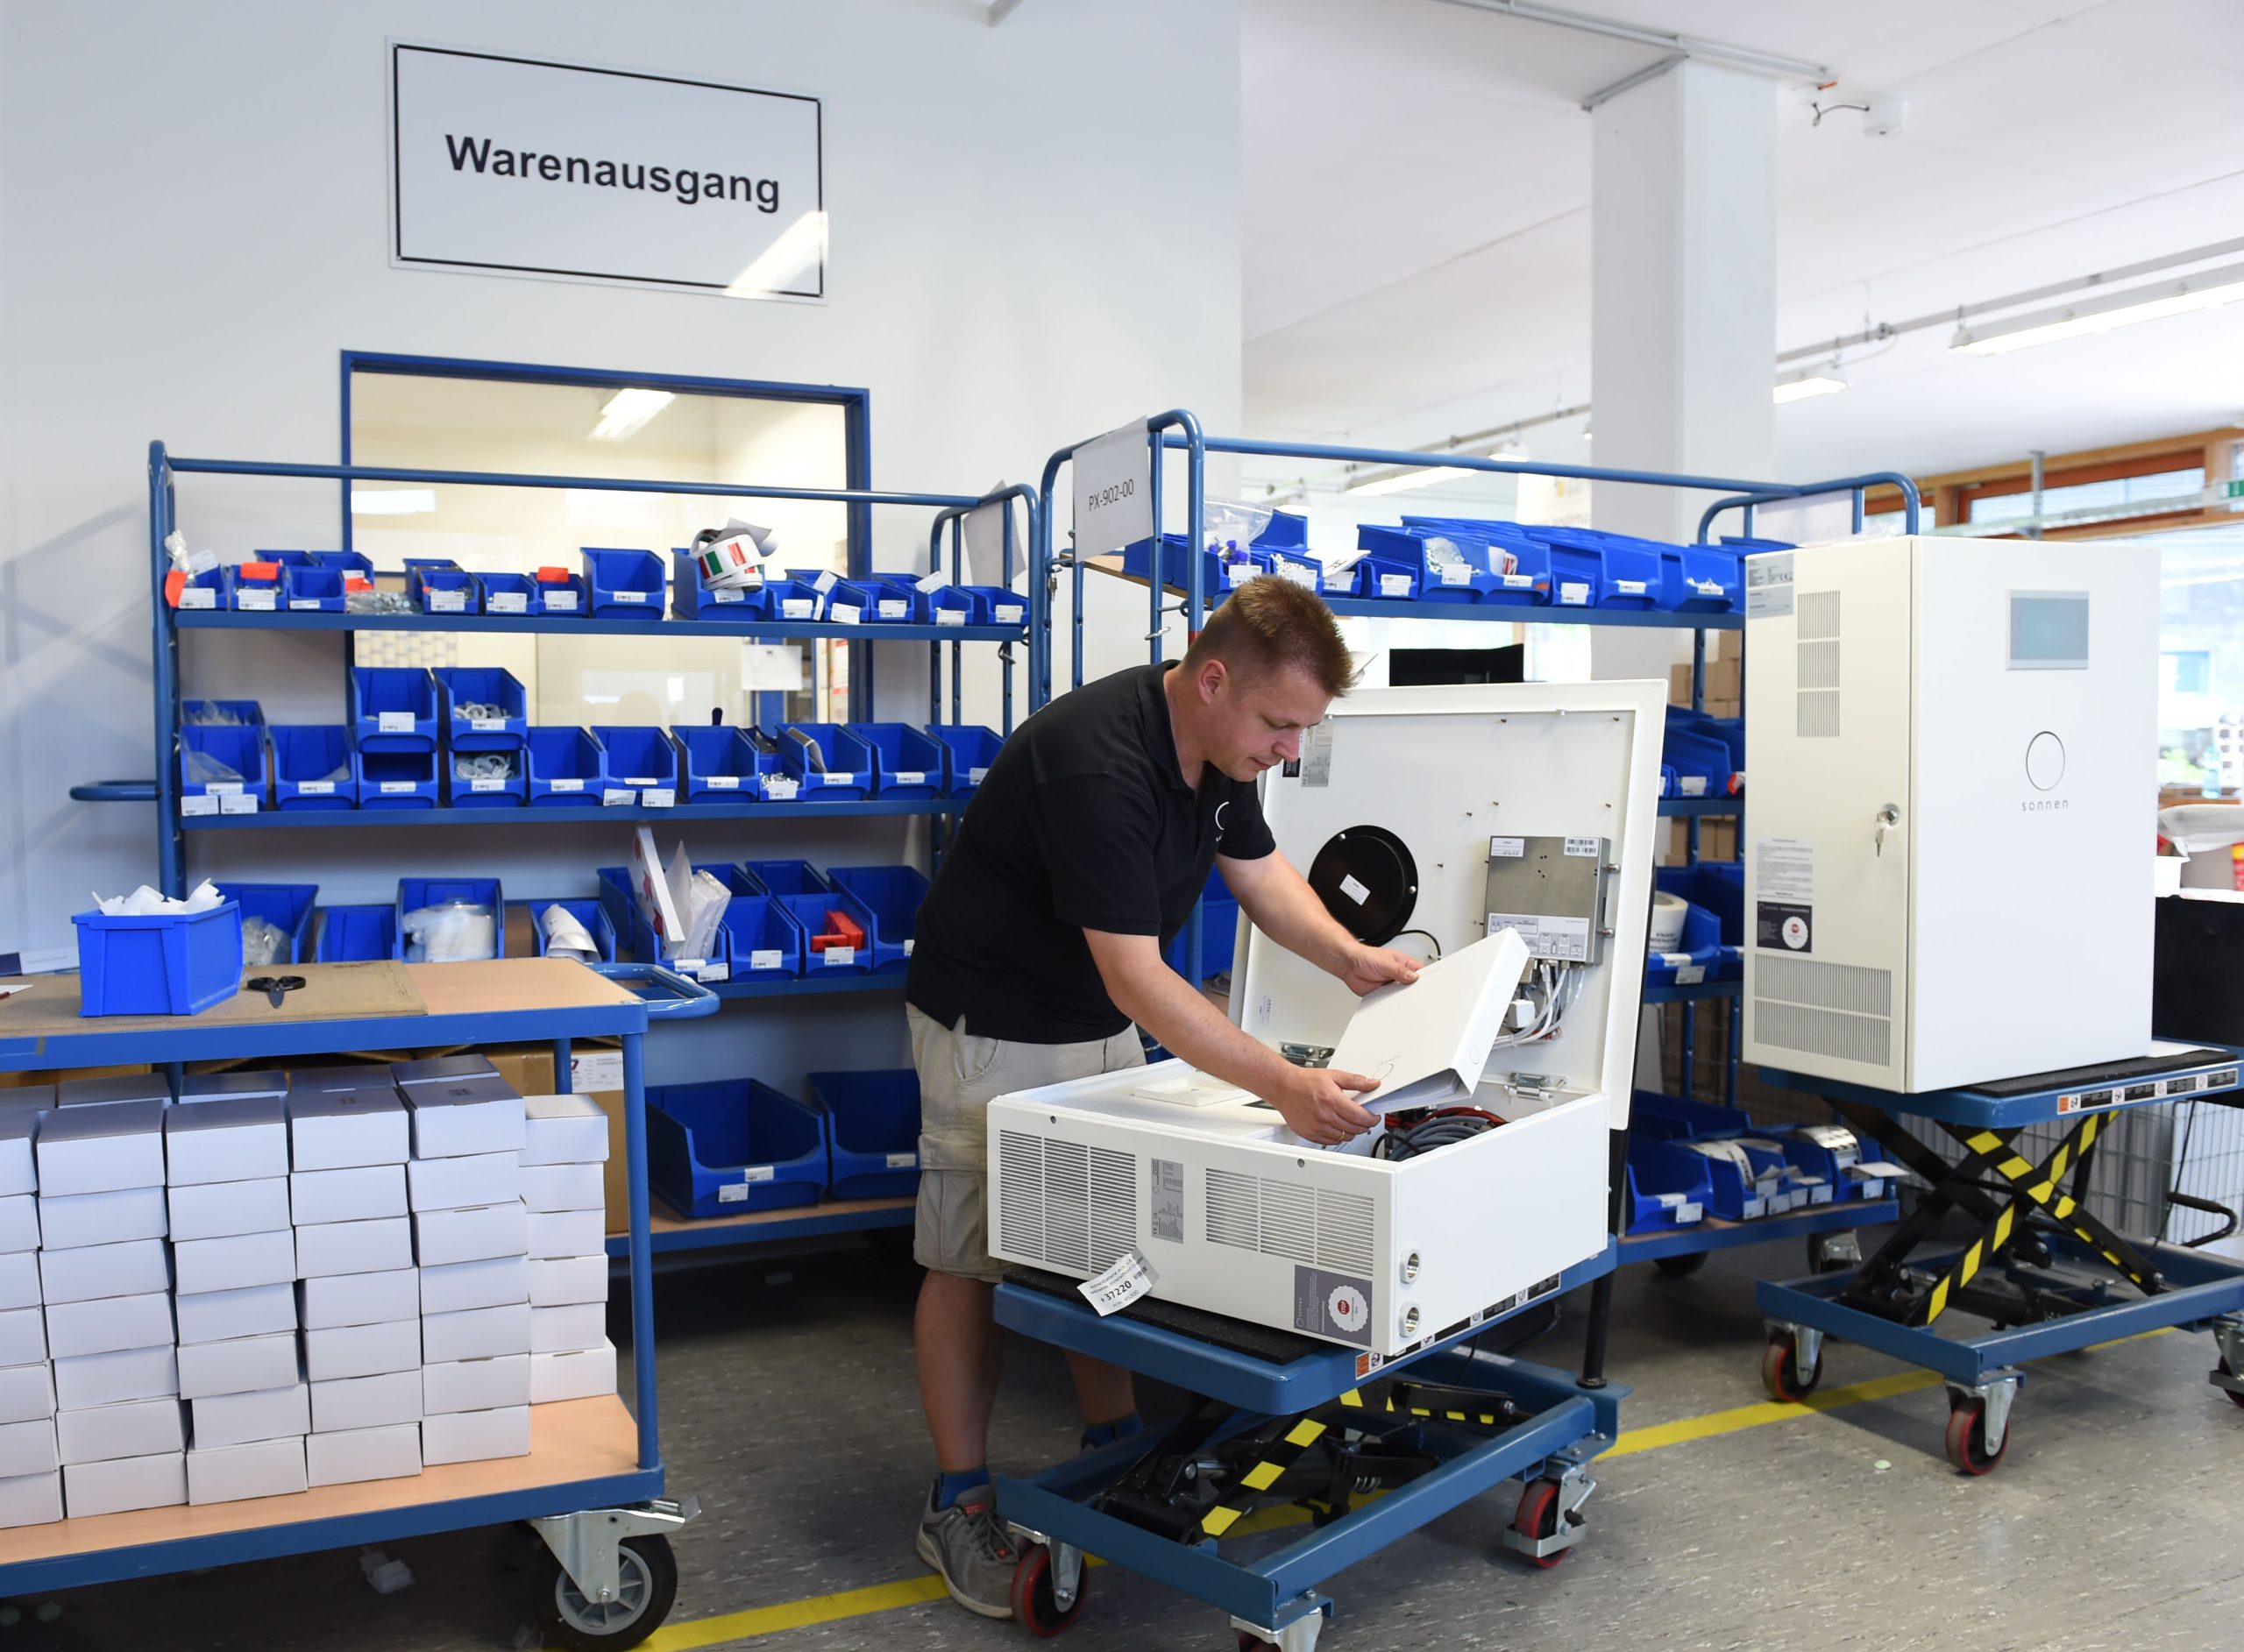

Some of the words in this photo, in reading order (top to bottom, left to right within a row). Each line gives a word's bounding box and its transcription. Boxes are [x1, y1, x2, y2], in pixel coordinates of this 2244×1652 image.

[444, 134, 780, 214] Warenausgang
[1089, 479, 1135, 512] PX-902-00
[2021, 799, 2069, 812] sonnen
[1104, 1280, 1133, 1301] 37220
